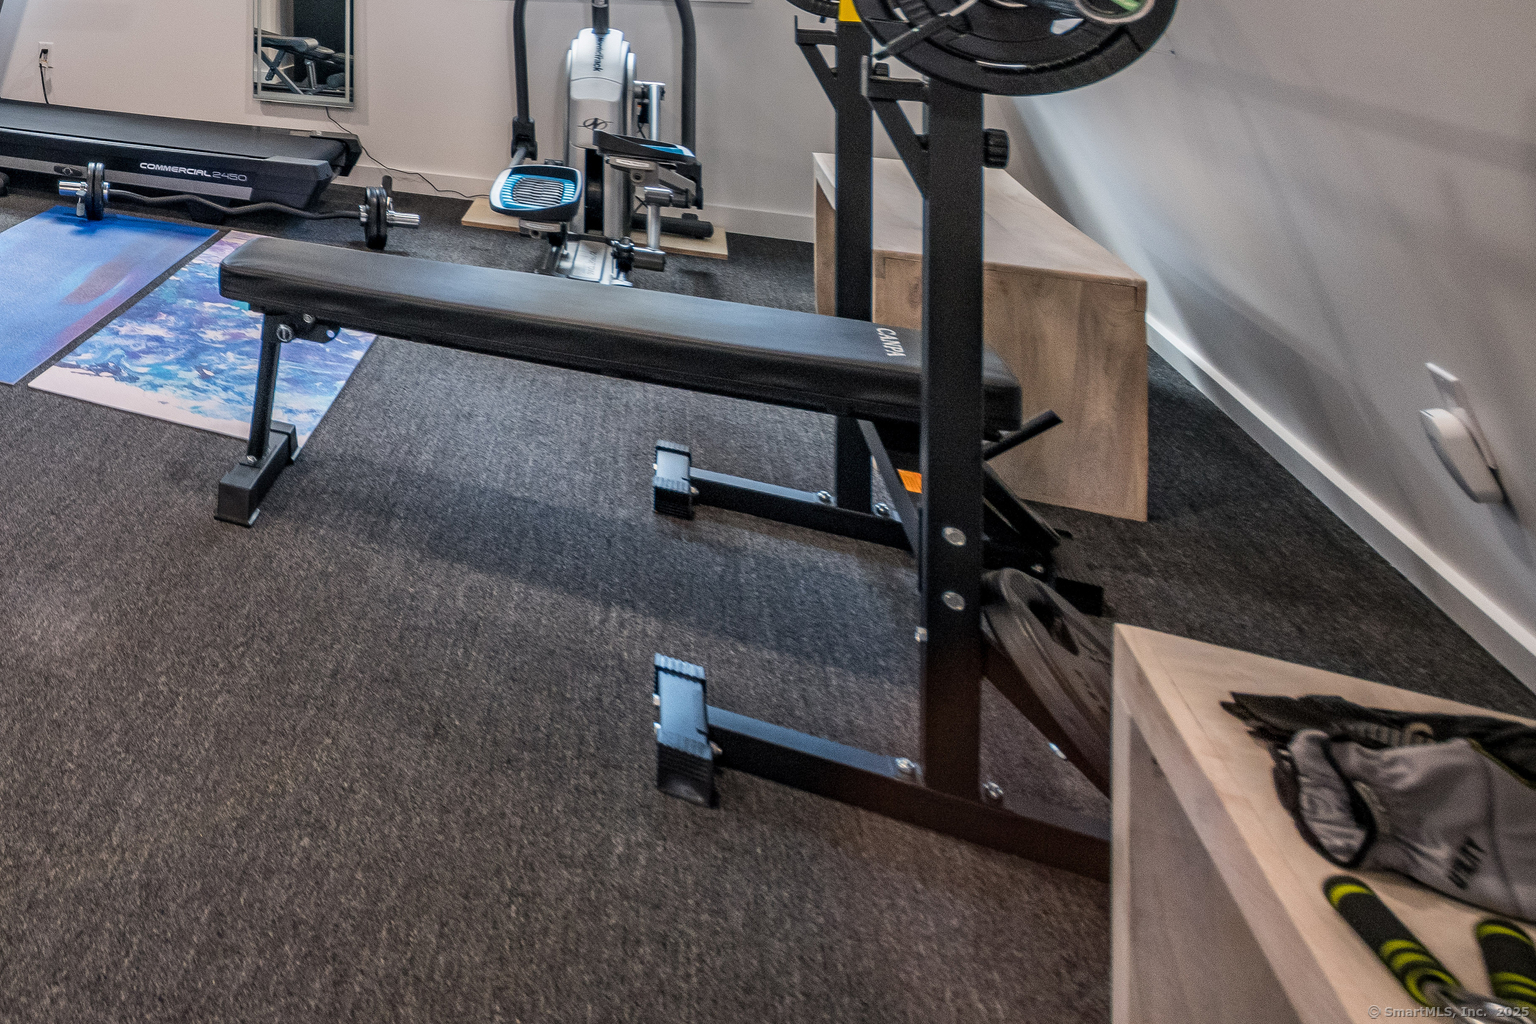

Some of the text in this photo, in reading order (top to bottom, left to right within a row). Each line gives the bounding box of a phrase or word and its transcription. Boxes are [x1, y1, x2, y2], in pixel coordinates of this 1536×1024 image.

[139, 162, 247, 182] COMMERCIAL 2450
[876, 327, 906, 357] CANPA
